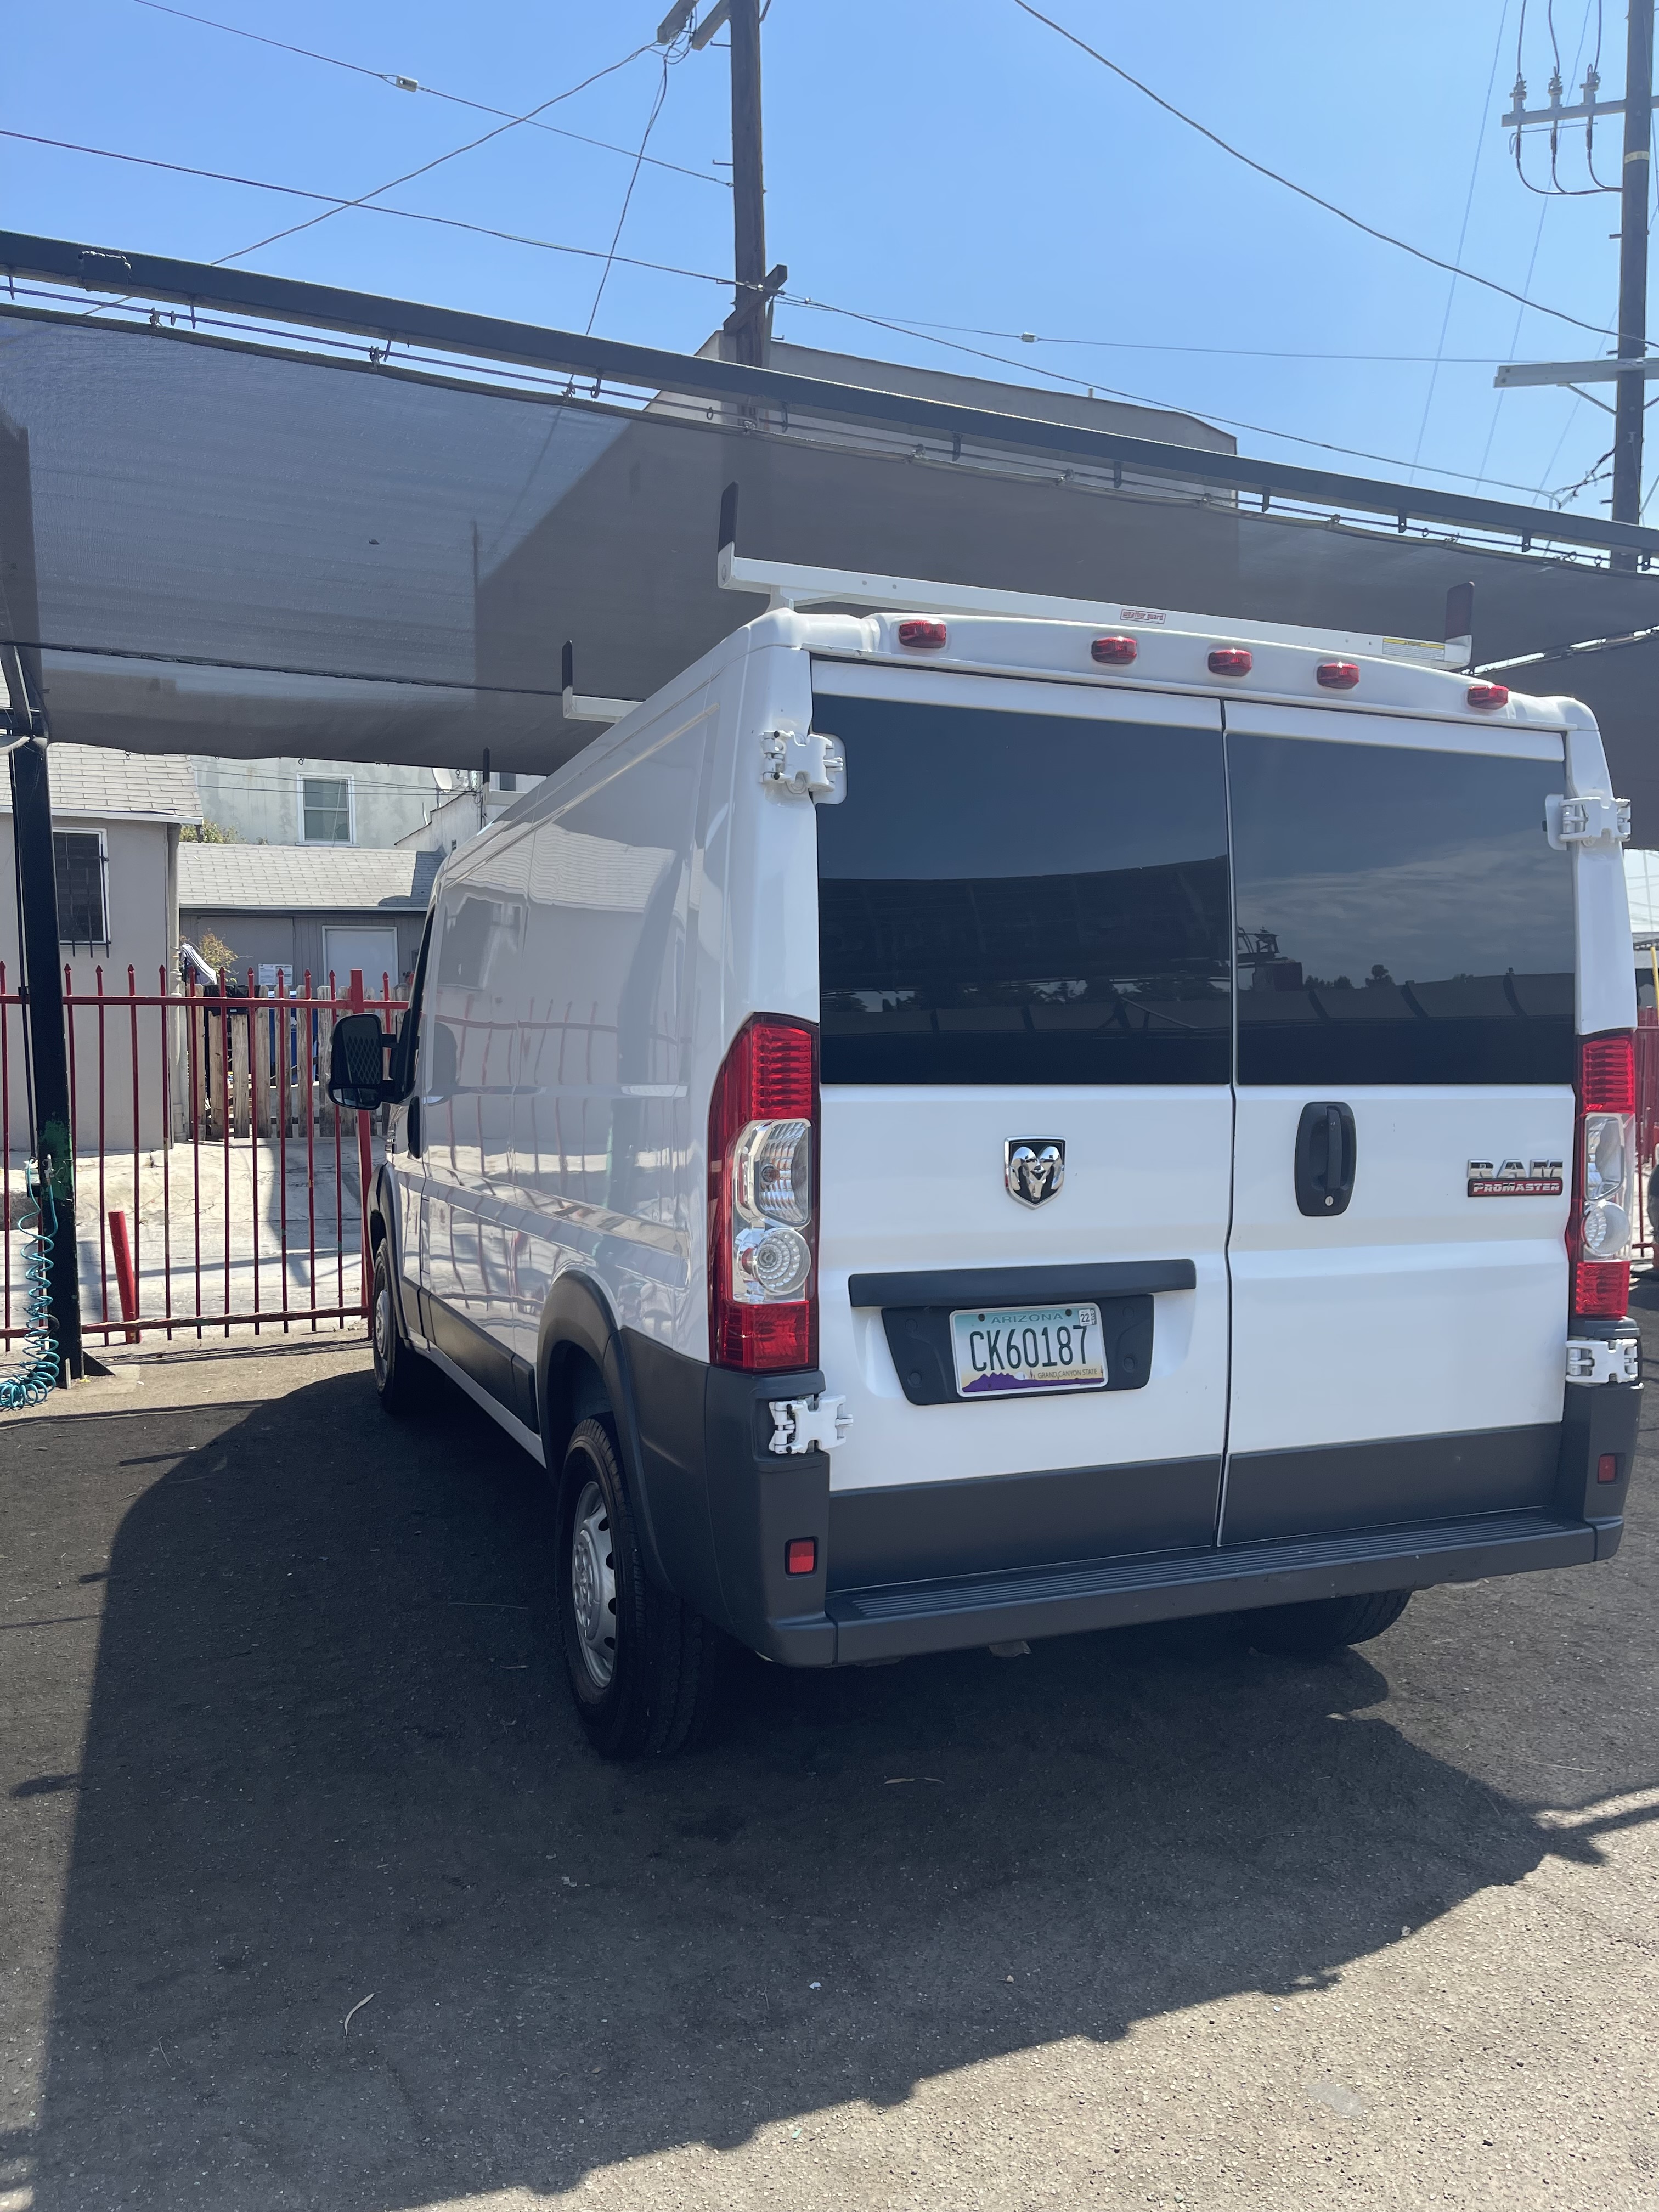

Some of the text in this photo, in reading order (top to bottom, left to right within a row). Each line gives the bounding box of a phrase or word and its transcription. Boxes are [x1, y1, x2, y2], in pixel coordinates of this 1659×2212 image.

[1468, 1159, 1563, 1179] RAM
[991, 1313, 1063, 1324] ARIZONA
[1080, 1313, 1090, 1323] 22
[969, 1325, 1087, 1372] CK60187
